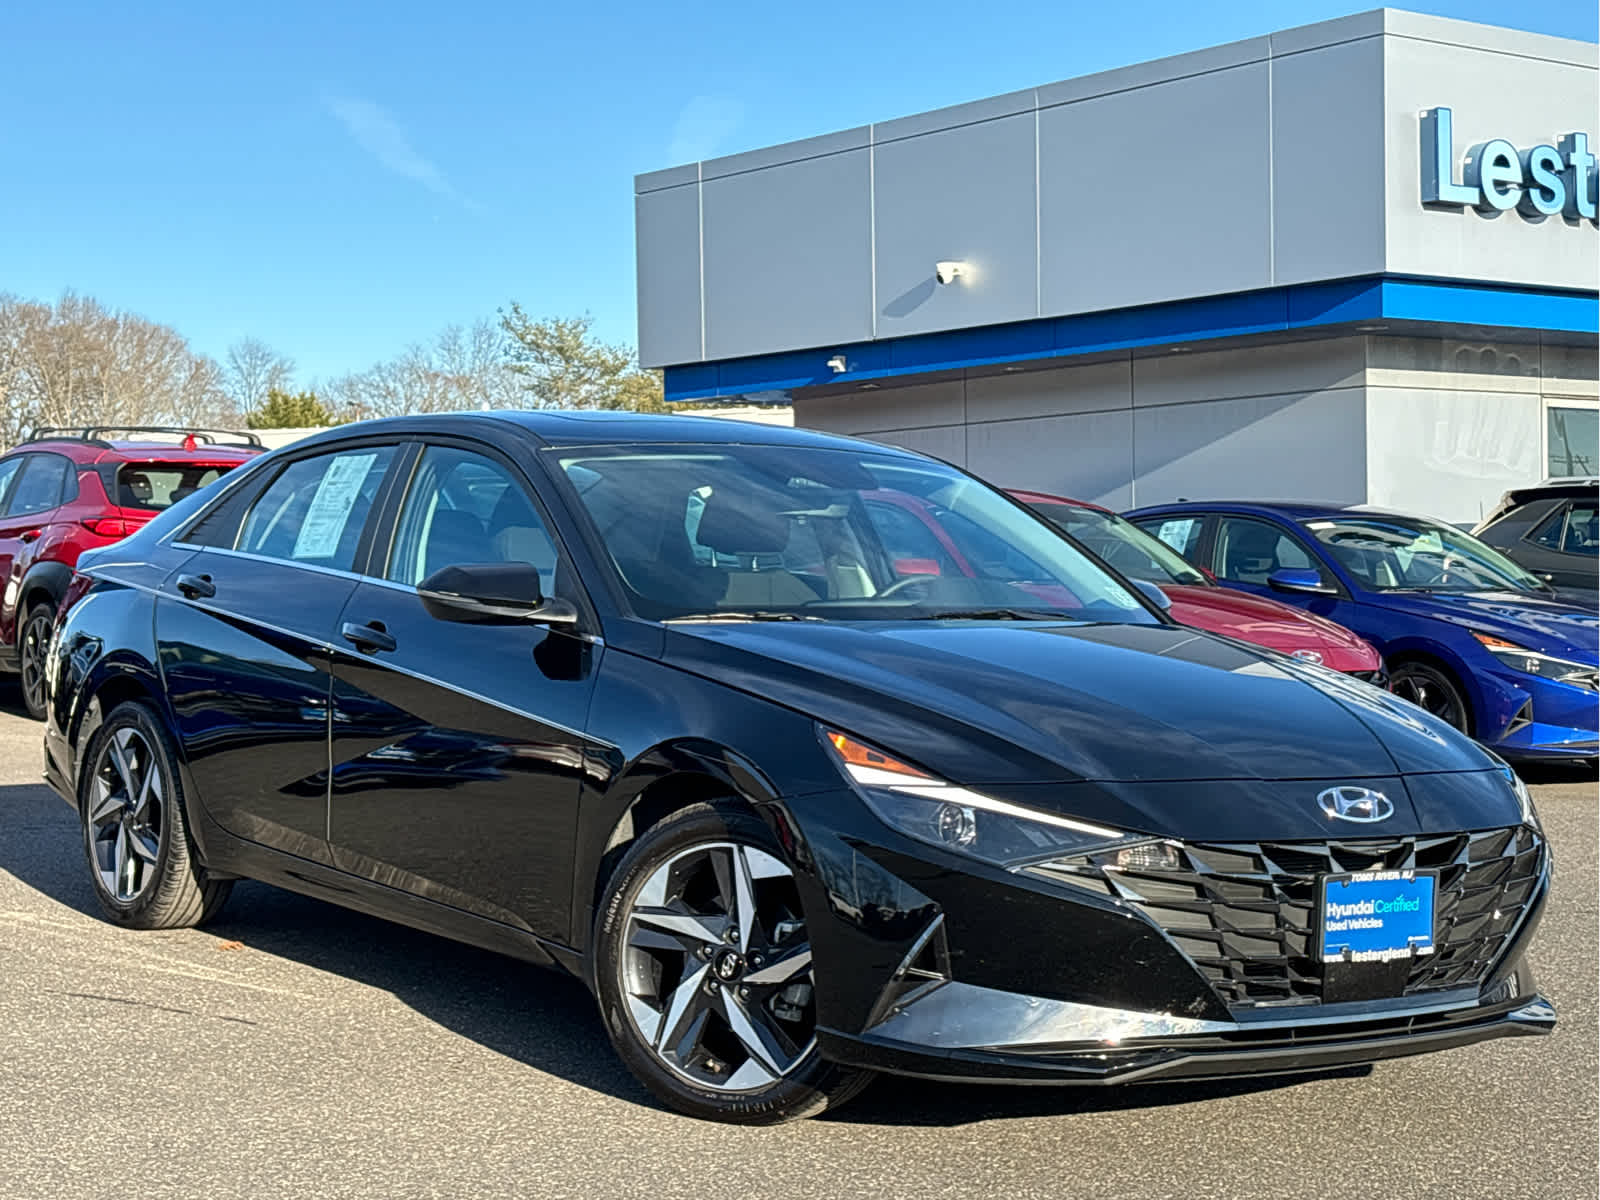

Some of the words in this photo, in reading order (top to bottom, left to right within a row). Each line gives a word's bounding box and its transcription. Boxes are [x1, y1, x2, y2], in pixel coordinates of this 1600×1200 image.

[1420, 107, 1599, 226] Lest
[1326, 900, 1375, 919] Hyundai
[1375, 895, 1420, 913] Certified
[1326, 920, 1347, 931] Used
[1348, 917, 1383, 929] Vehicles
[1351, 947, 1411, 962] lesterglenn
